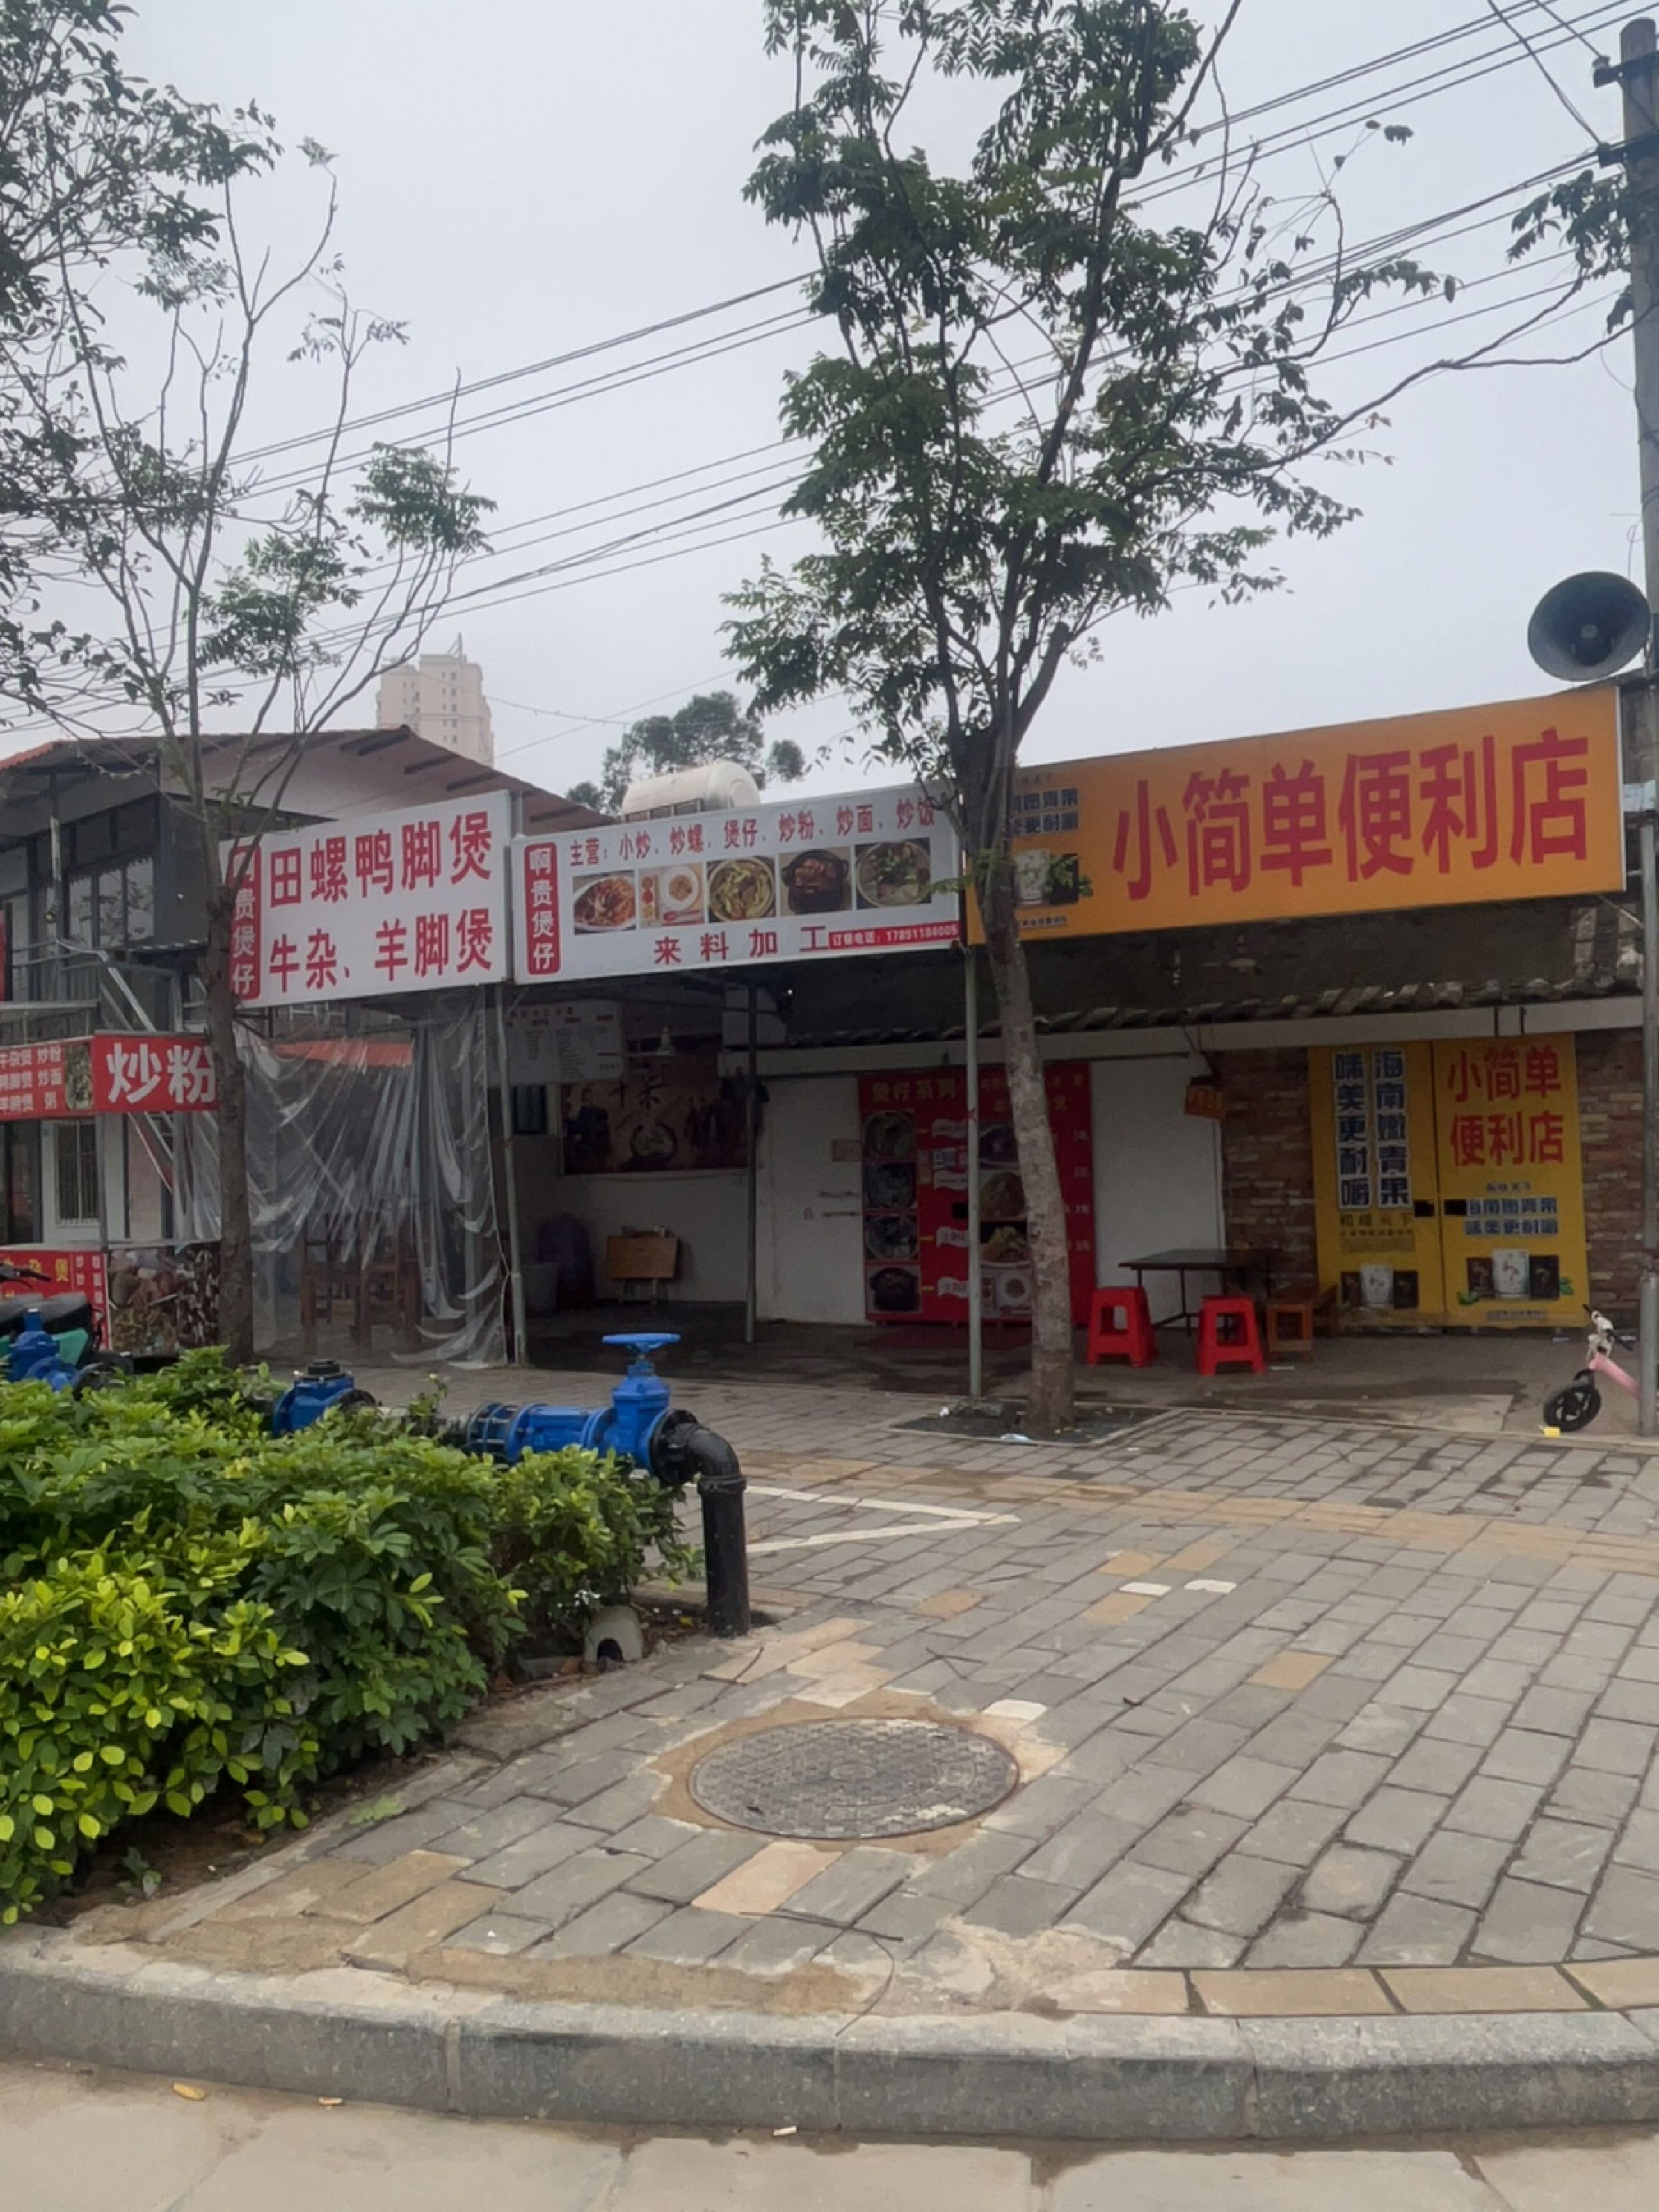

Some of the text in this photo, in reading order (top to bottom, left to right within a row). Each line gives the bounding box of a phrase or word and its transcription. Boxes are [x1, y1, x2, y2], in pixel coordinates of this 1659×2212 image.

[1113, 728, 1589, 900] 小简单便利店
[270, 811, 492, 908] 田螺鸭脚煲
[529, 847, 555, 970] 啊贵煲仔
[269, 908, 493, 993] 牛杂、羊脚煲
[653, 925, 829, 966] 来料加工
[106, 1043, 218, 1104] 炒粉
[1447, 1046, 1562, 1102] 小简单
[1450, 1110, 1564, 1167] 便利店
